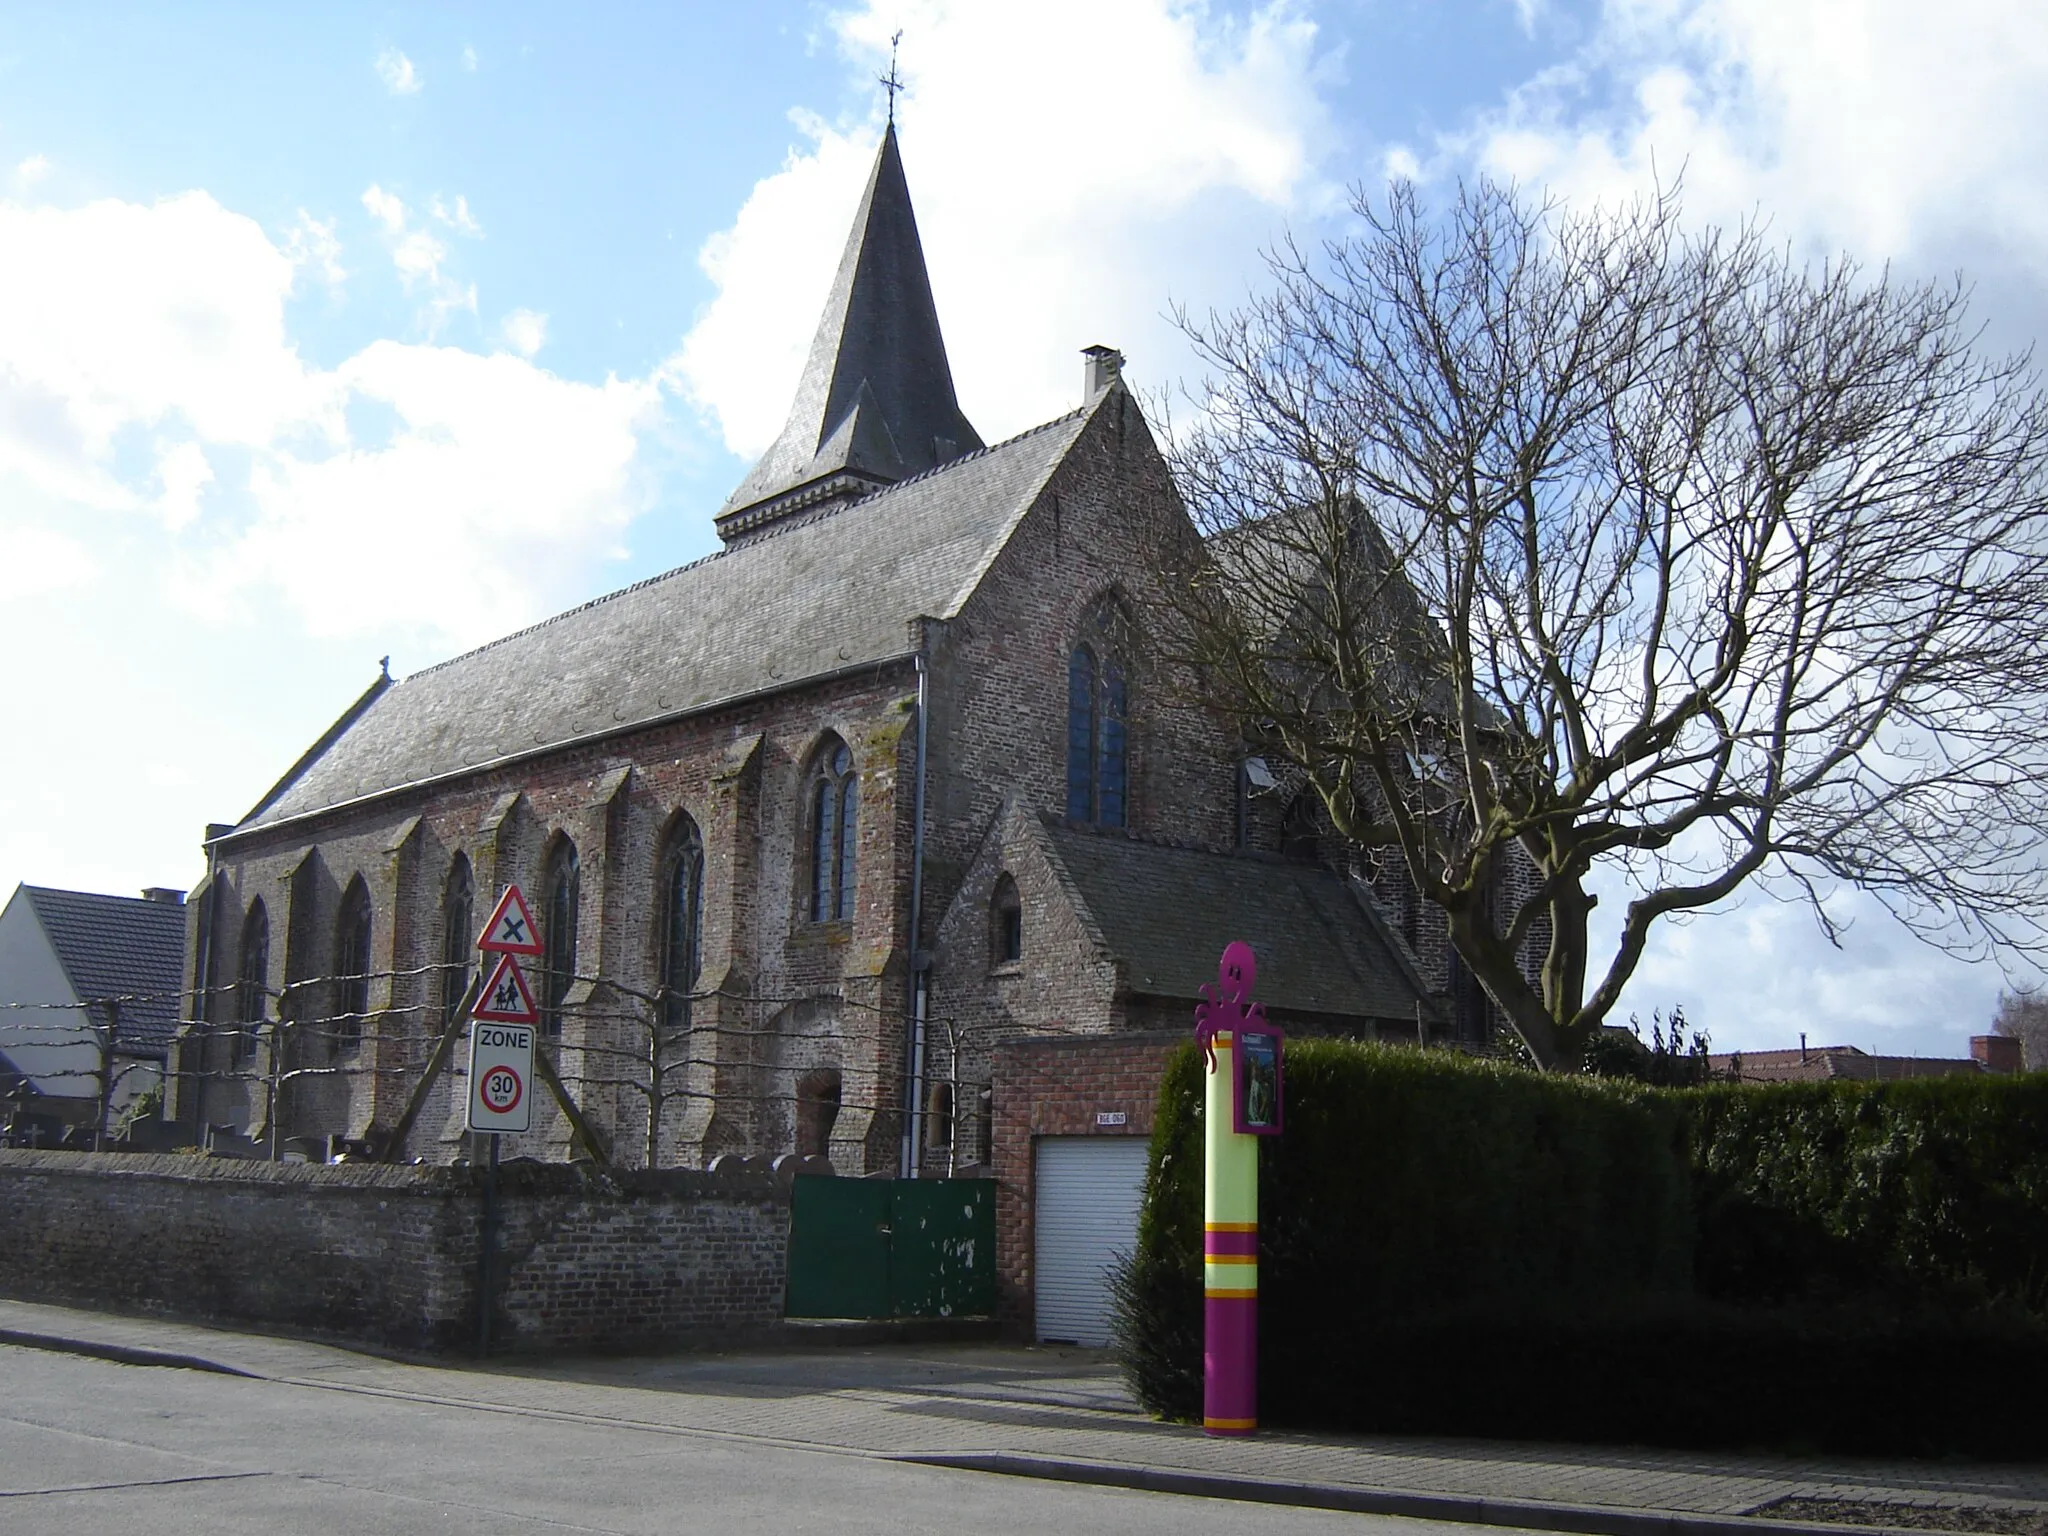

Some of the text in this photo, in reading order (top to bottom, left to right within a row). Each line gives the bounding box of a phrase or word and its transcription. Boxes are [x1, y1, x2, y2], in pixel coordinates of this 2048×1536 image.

[481, 1030, 528, 1048] ZONE
[491, 1076, 513, 1093] 30
[495, 1094, 508, 1102] km
